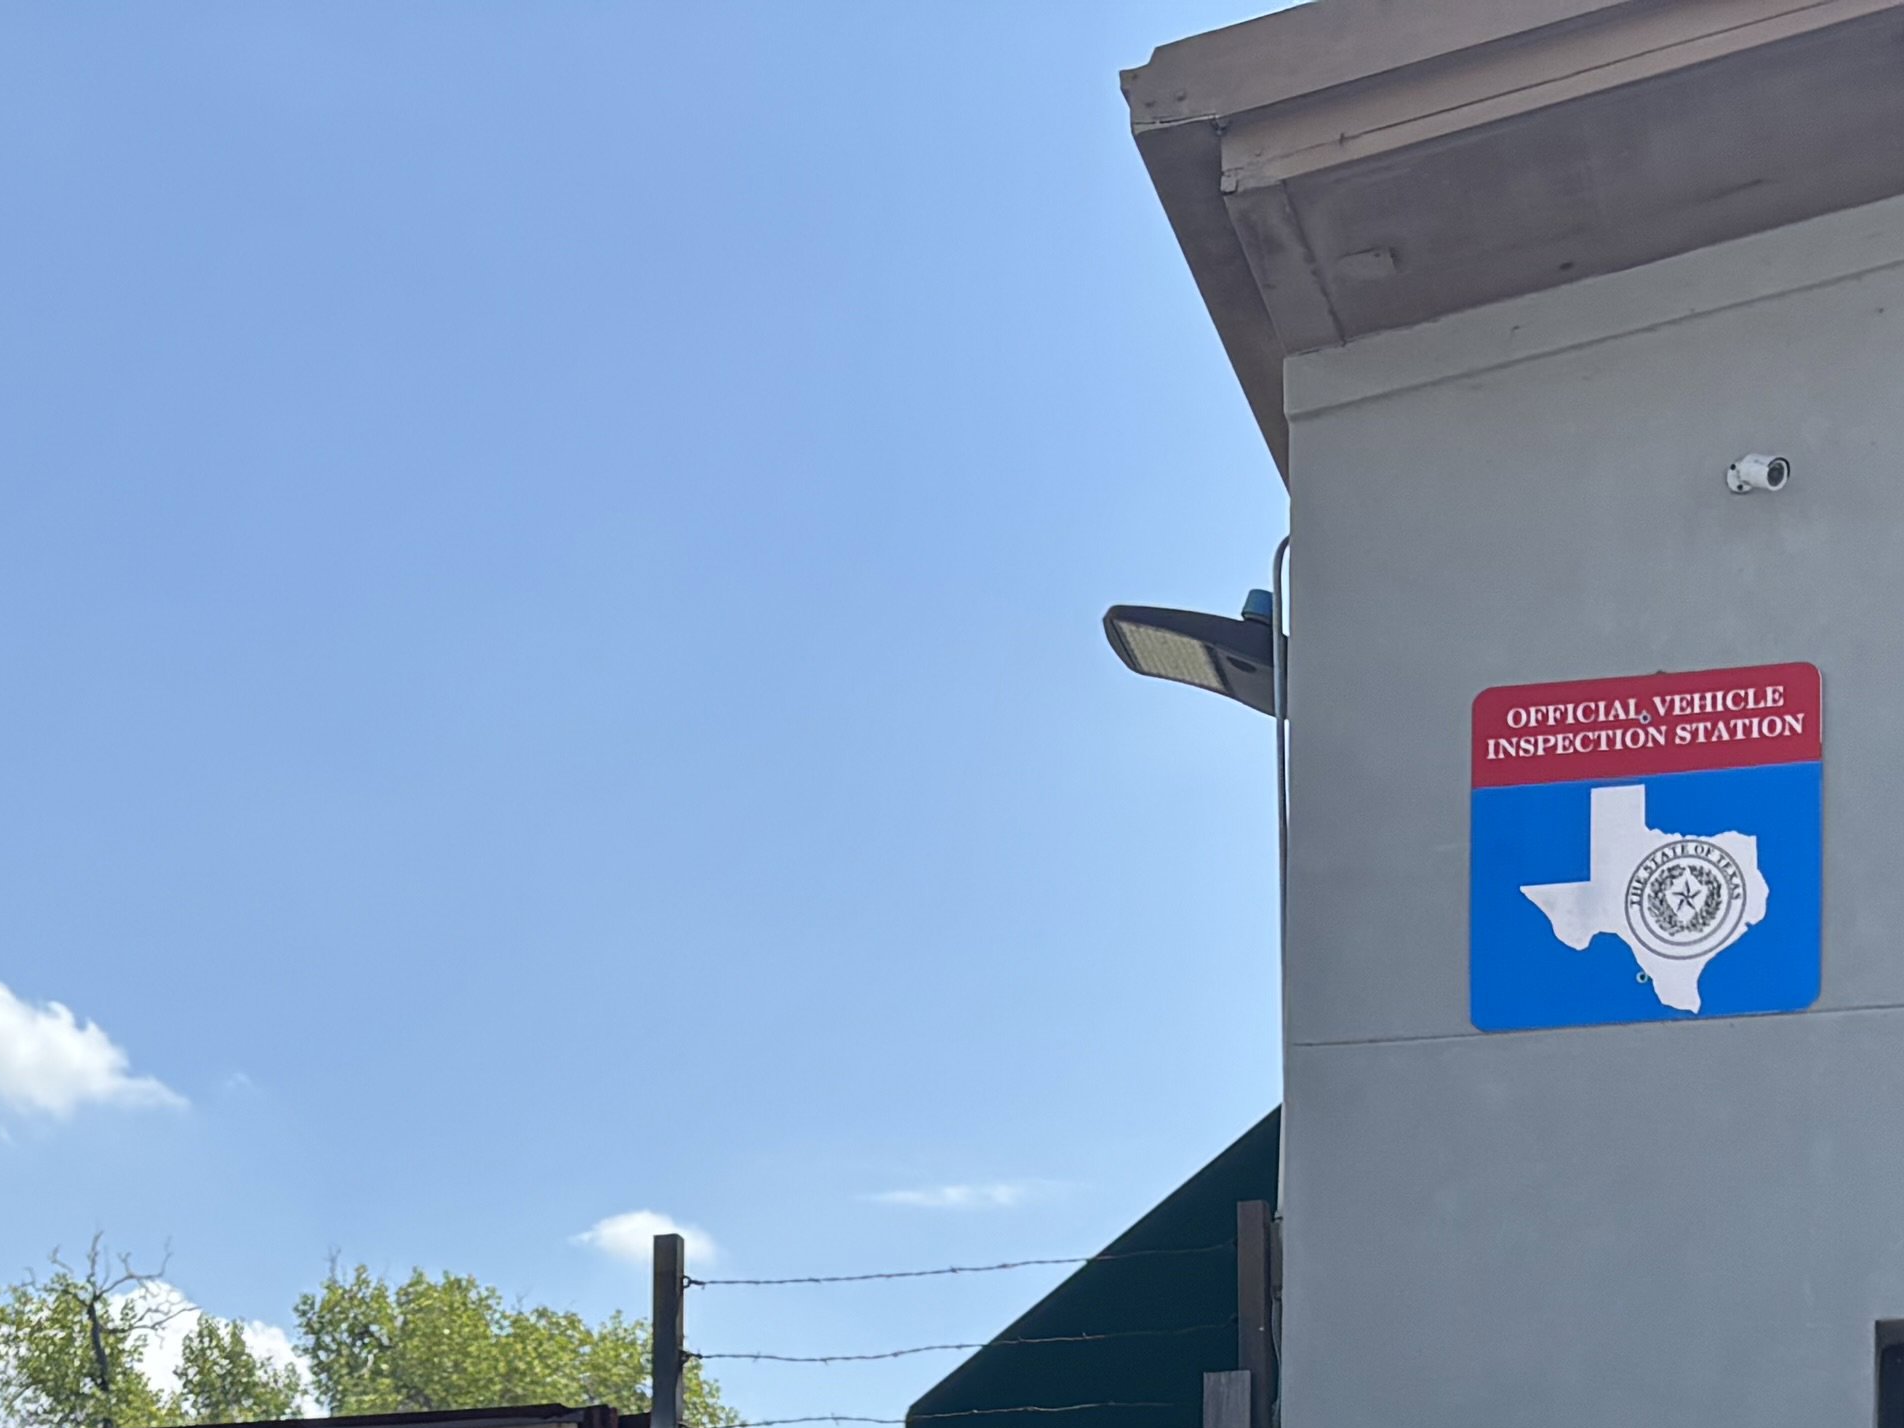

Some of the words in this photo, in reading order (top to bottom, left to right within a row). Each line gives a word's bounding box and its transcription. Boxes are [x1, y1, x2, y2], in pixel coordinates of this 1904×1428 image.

[1506, 698, 1646, 729] OFFICIAL
[1652, 686, 1785, 717] VEHICLE
[1486, 725, 1668, 760] INSPECTION
[1674, 713, 1806, 746] STATION
[1630, 875, 1645, 908] THE
[1643, 844, 1690, 873] STATE
[1694, 844, 1715, 858] OF
[1716, 854, 1742, 900] TEXAS
